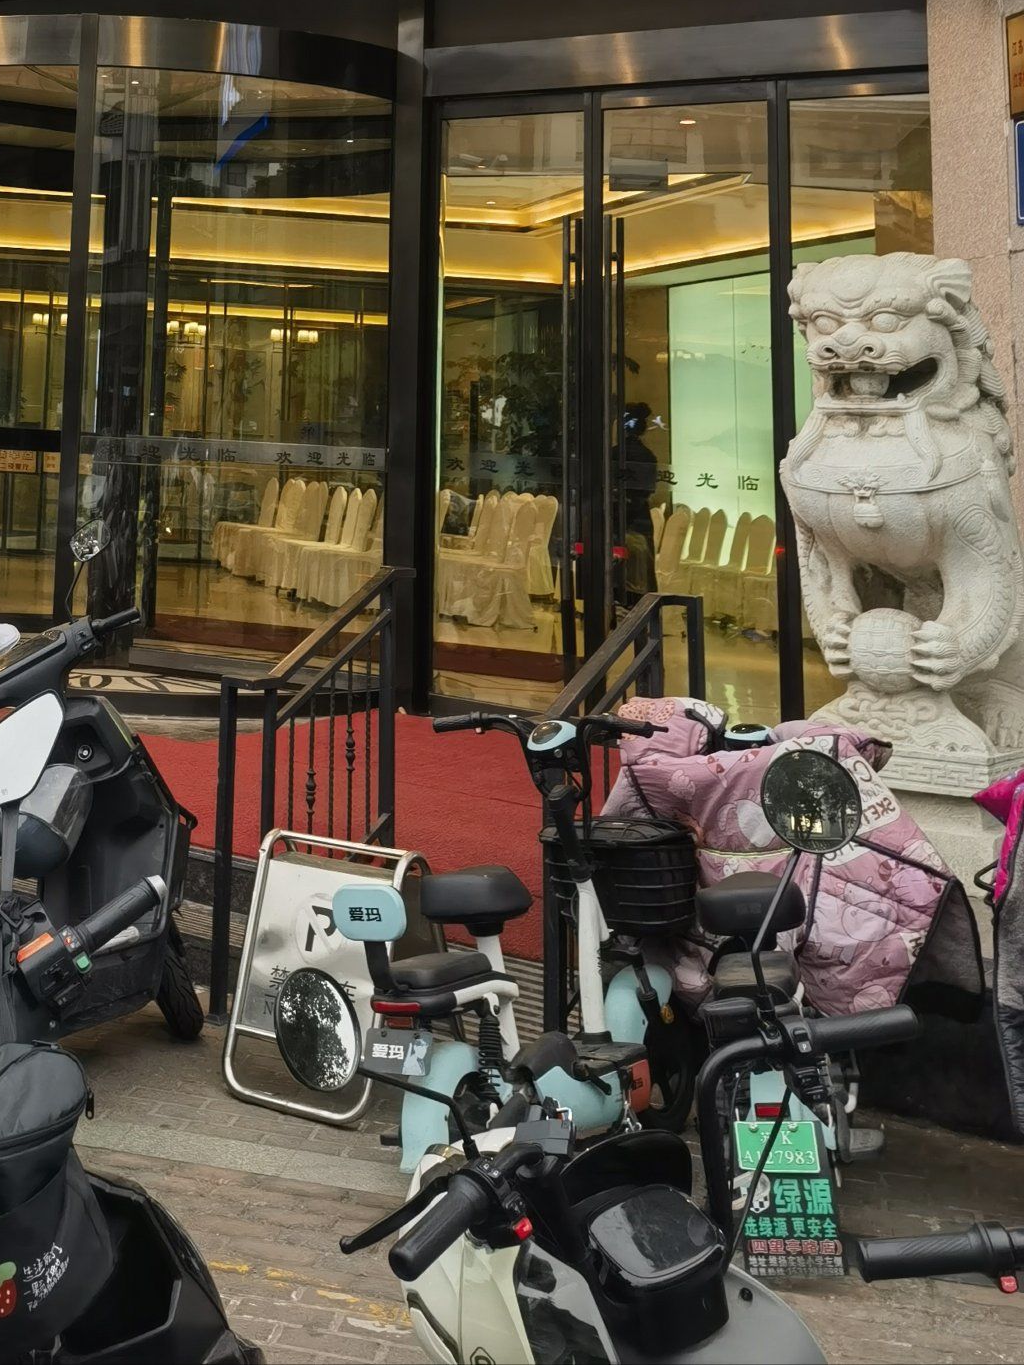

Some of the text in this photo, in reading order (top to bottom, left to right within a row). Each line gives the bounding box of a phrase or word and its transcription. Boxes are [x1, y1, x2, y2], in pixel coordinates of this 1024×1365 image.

[276, 449, 377, 468] 欢迎光临
[348, 906, 383, 922] 爱玛
[372, 1043, 405, 1060] 爱玛
[743, 1150, 816, 1165] A127983
[773, 1178, 834, 1215] 绿源
